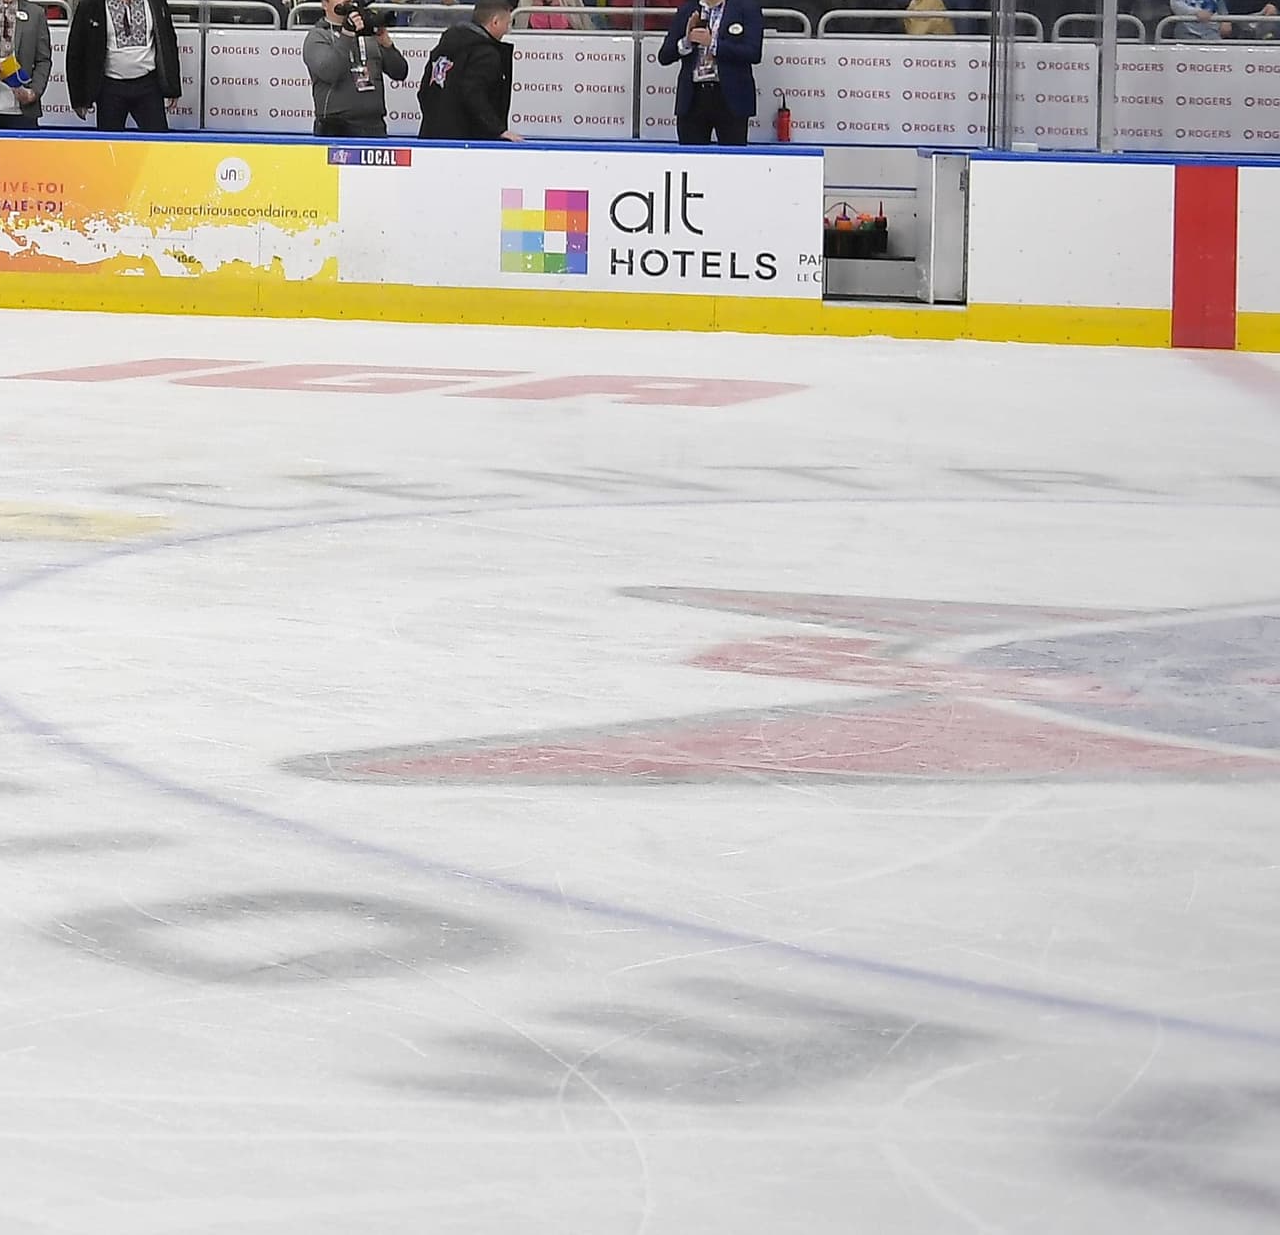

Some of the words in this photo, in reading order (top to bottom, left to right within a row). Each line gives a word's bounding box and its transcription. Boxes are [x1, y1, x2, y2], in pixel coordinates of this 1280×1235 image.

[222, 47, 260, 56] ROGERS
[281, 48, 303, 57] ROG
[402, 49, 429, 58] ROGE
[524, 51, 565, 61] ROGERS
[587, 53, 627, 63] ROGERS
[785, 56, 827, 65] ROGERS
[850, 57, 892, 67] ROGERS
[915, 58, 957, 68] ROGERS
[1048, 62, 1091, 72] ROGERS
[1121, 63, 1165, 72] ROGERS
[1189, 64, 1233, 74] ROGERS
[1258, 65, 1280, 75] ROG
[222, 77, 260, 86] ROGERS
[524, 82, 564, 91] ROGERS
[586, 84, 626, 94] ROGERS
[785, 88, 826, 97] ROGERS
[849, 90, 891, 99] ROGERS
[915, 91, 956, 101] ROGERS
[1048, 94, 1090, 104] ROGERS
[1121, 96, 1165, 106] ROGERS
[1188, 97, 1232, 107] ROGERS
[1257, 98, 1280, 108] ROG
[221, 108, 259, 117] ROGERS
[523, 114, 563, 124] ROGERS
[585, 115, 625, 125] ROGERS
[789, 120, 825, 130] OGERS
[849, 121, 891, 131] ROGERS
[914, 123, 956, 133] ROGERS
[1047, 126, 1089, 136] ROGERS
[1121, 128, 1164, 137] ROGERS
[1188, 129, 1232, 139] ROGERS
[1256, 130, 1280, 140] ROG
[360, 150, 397, 165] LOCAL
[610, 171, 704, 235] alt
[610, 248, 778, 280] HOTELS
